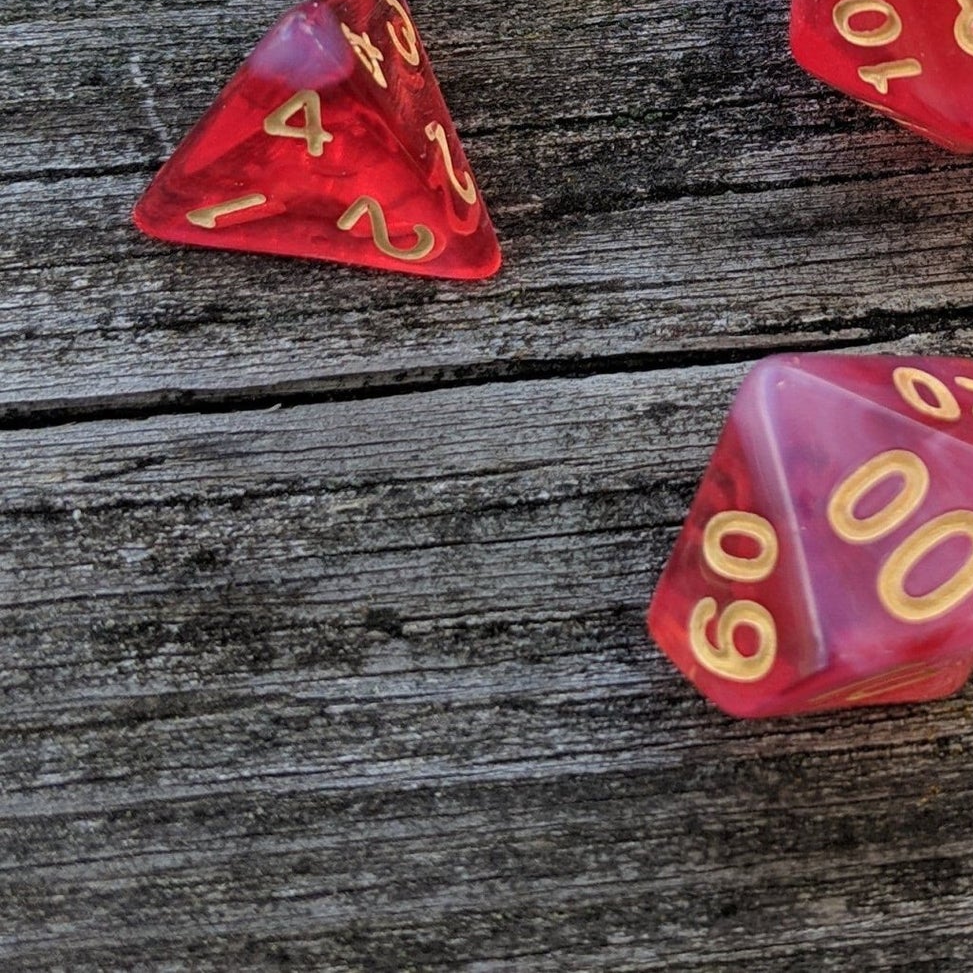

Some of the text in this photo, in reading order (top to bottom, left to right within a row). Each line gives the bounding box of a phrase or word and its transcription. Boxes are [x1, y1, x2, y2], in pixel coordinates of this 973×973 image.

[264, 90, 333, 156] 4
[186, 194, 266, 228] 1
[337, 195, 434, 261] 2
